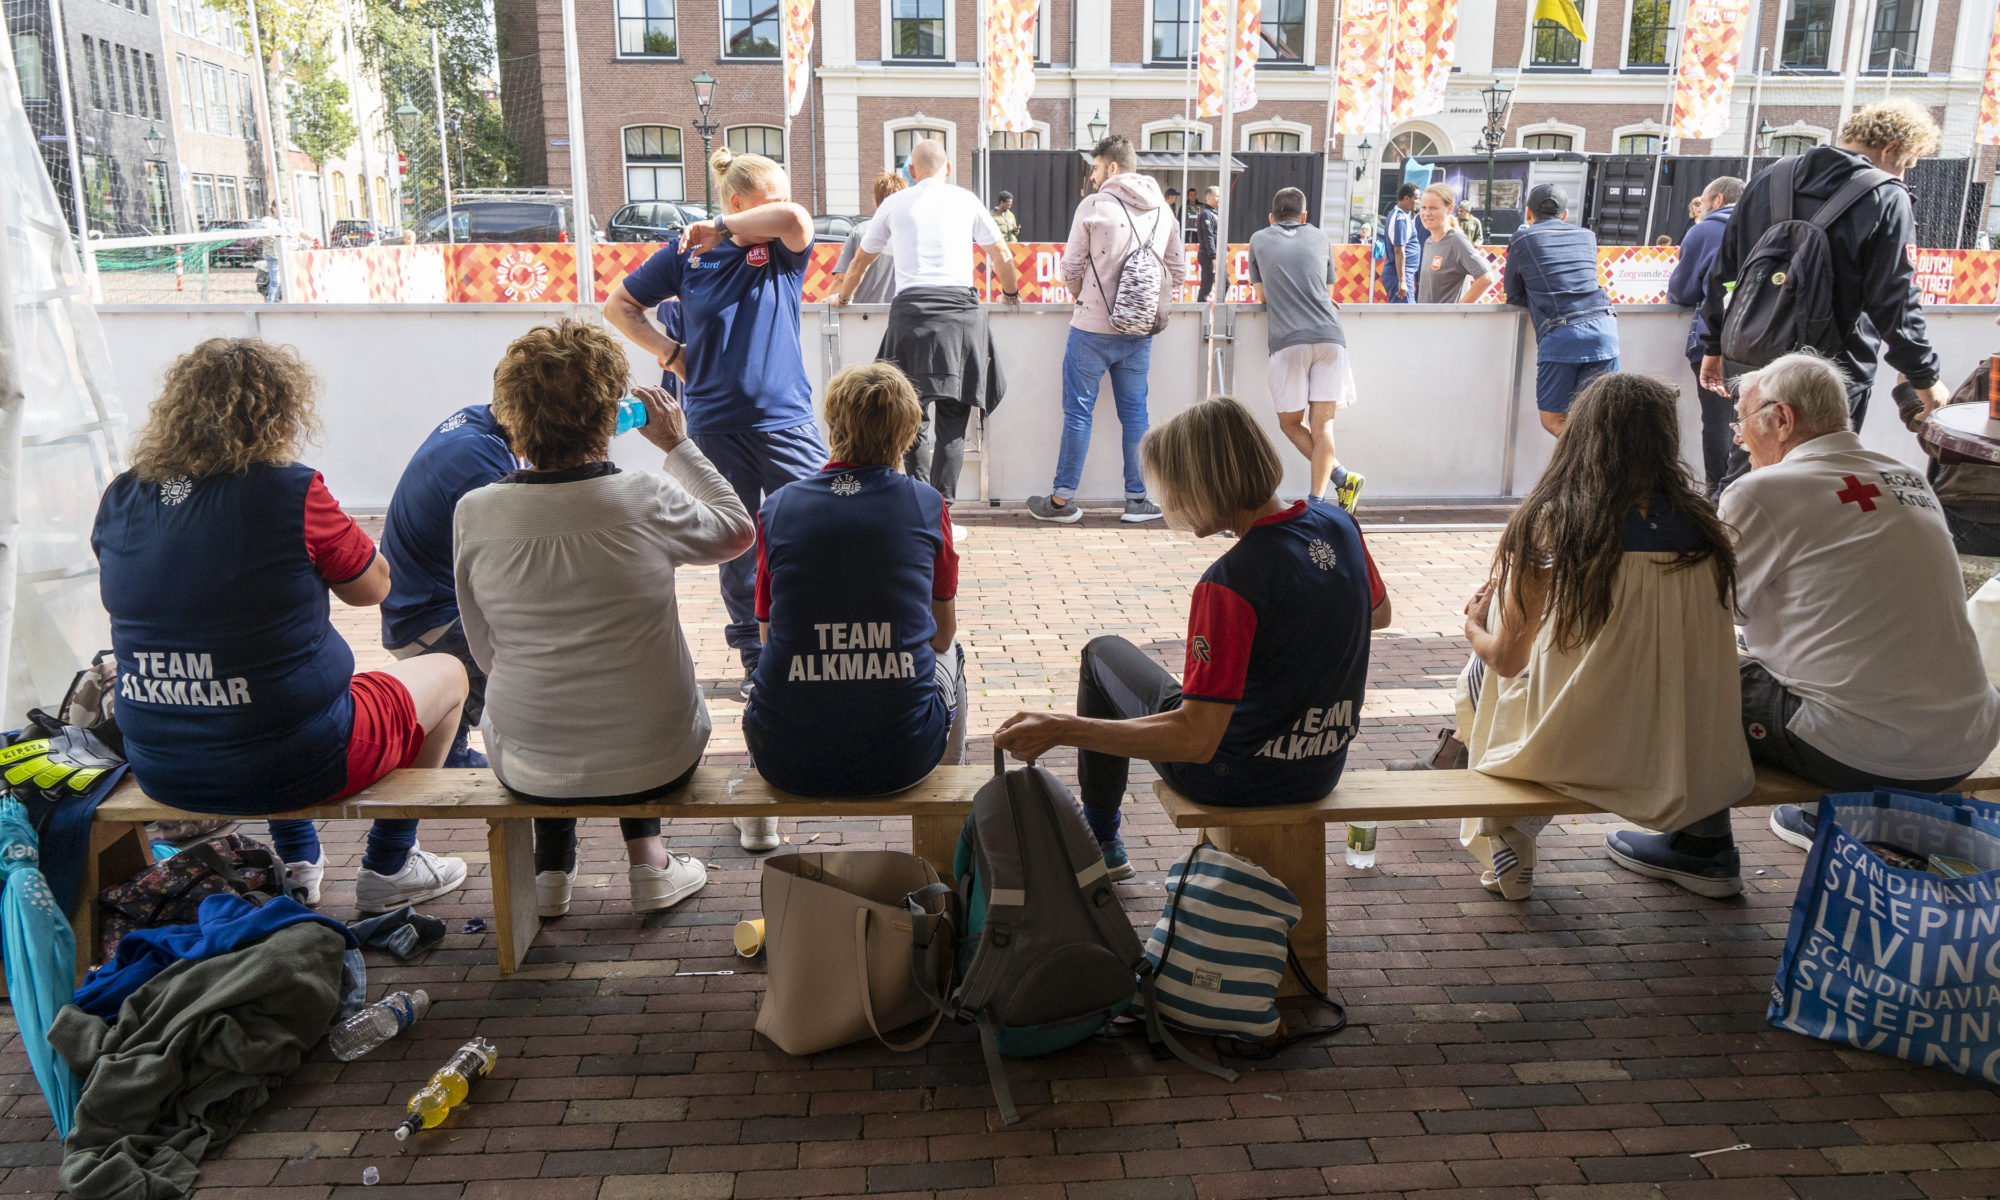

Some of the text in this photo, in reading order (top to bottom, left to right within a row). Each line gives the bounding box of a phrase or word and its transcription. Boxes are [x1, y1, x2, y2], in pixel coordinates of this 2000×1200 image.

[1693, 7, 1720, 24] CUP
[749, 247, 766, 257] LIFE
[1618, 269, 1636, 279] Zorg
[1652, 269, 1662, 278] de
[1662, 269, 1672, 278] Za
[1918, 256, 1953, 273] DUTCH
[496, 251, 549, 302] MOVE TO INSPIRE TO
[1916, 274, 1955, 292] STREET
[1042, 286, 1075, 304] MOV
[1879, 471, 1924, 490] Rode
[814, 622, 892, 650] TEAM
[133, 652, 214, 680] TEAM
[788, 651, 917, 682] ALKMAAR
[121, 672, 252, 706] ALKMAAR
[1834, 834, 2000, 904] SCANDINAVI
[1794, 959, 2000, 1043] SLEEPIN
